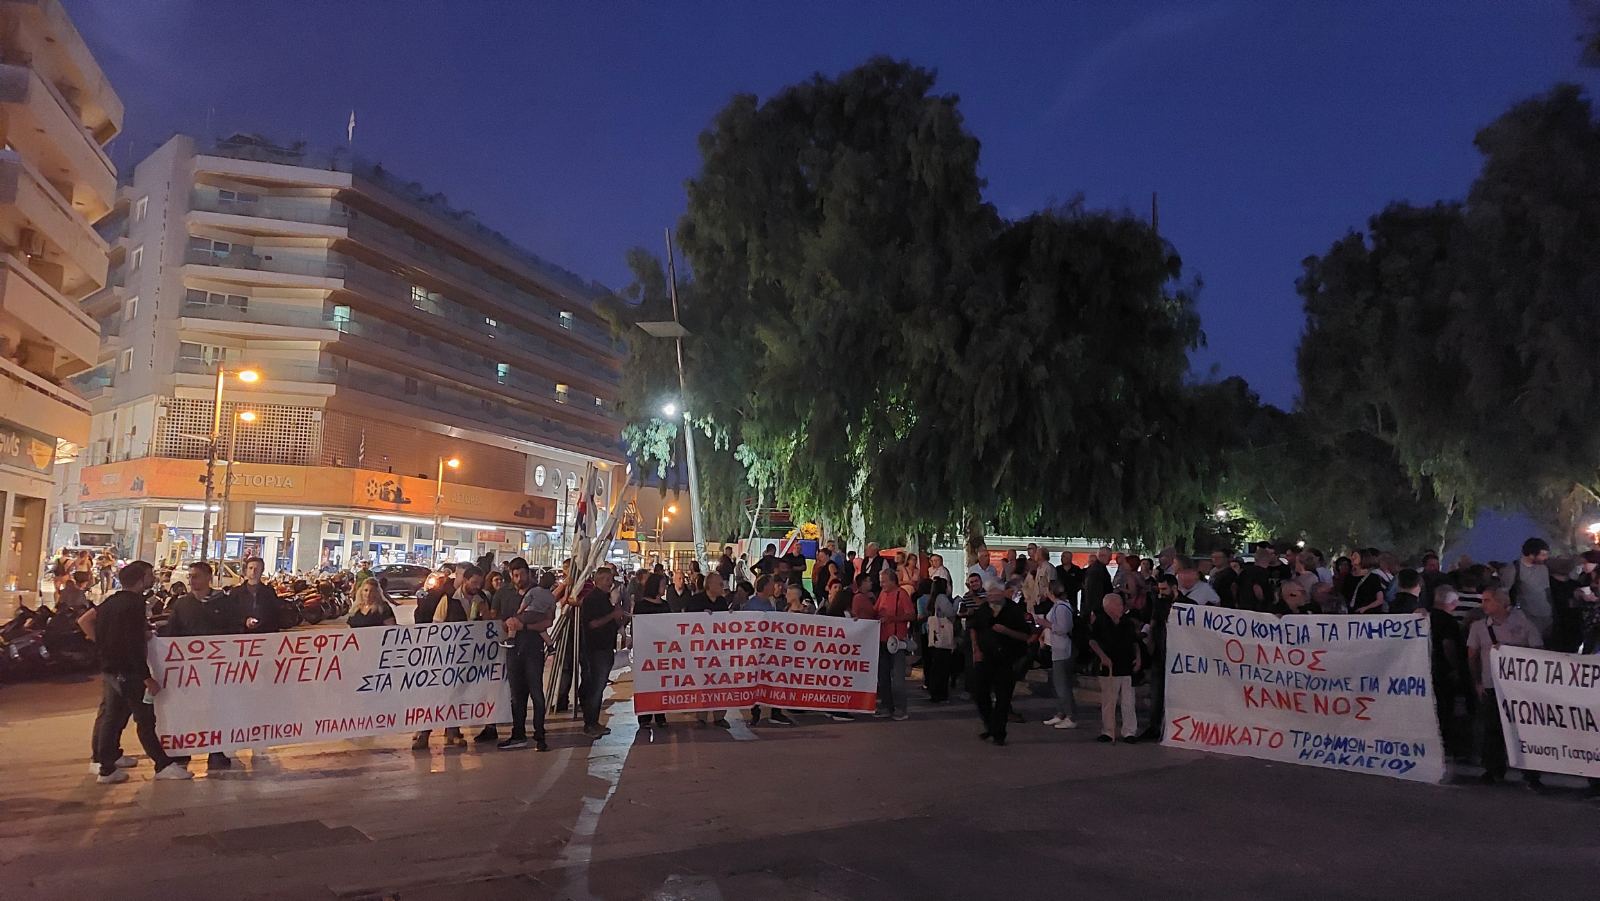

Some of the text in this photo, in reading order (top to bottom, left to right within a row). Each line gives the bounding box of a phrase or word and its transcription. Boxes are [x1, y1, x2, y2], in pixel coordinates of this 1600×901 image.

[381, 622, 499, 646] ΓΙΑΤΡΟΥΣ &
[676, 620, 846, 639] ΤΑ ΝΟΣΟΚΟΜΕΙΑ
[1172, 605, 1428, 645] ΤΑ ΝΟΣΟΚΟΜΕΙΑ ΤΑ ΠΛΗΡΩΣΕ
[277, 633, 360, 656] ΛΕΦΤΑ
[379, 641, 499, 669] ΕΞΟΠΛΗΣΜΟ
[653, 636, 862, 656] ΤΑ ΠΛΗΡΩΣΕ Ο ΛΑΟΣ
[1225, 639, 1327, 672] Ο ΛΑΟΣ
[163, 655, 342, 688] ΓΙΑ ΤΗΝ ΥΓΕΙΑ
[641, 653, 870, 673] ΔΕΝ ΤΑ ΠΑΖΑΡΕΥΟΥΜΕ
[1171, 652, 1426, 697] ΔΕΝ ΤΑ ΠΑΖΑΡΕΥΟΥΜΕ ΓΙΑ ΧΑΡΗ
[1499, 656, 1539, 682] ΚΑΤΩ
[1544, 660, 1564, 685] ΤΑ
[356, 663, 508, 694] ΣΤΑ ΝΟΣΟΚΟΜΕΙ
[660, 669, 854, 688] ΓΙΑ ΧΑΡΗ ΚΑΝΕΝΟΣ
[662, 693, 697, 705] ΕΝΩΣΗ
[769, 691, 786, 701] ΙΚΑ
[801, 693, 852, 704] ΗΡΑΚΛΕΙΟΥ
[1243, 685, 1376, 721] ΚΑΝΕΝΟΣ
[161, 701, 495, 750] ΕΝΩΣΗ ΙΔΙΩΤΙΚΩΝ ΥΠΑΛΛΗΛΩΝ ΗΡΑΚΛΕΙΟΥ
[1171, 715, 1284, 749] ΣΥΝΔΙΚΑΤΟ
[1569, 706, 1599, 732] ΓΙΑ
[1299, 748, 1417, 774] ΗΡΑΚΛΕΙΟΥ
